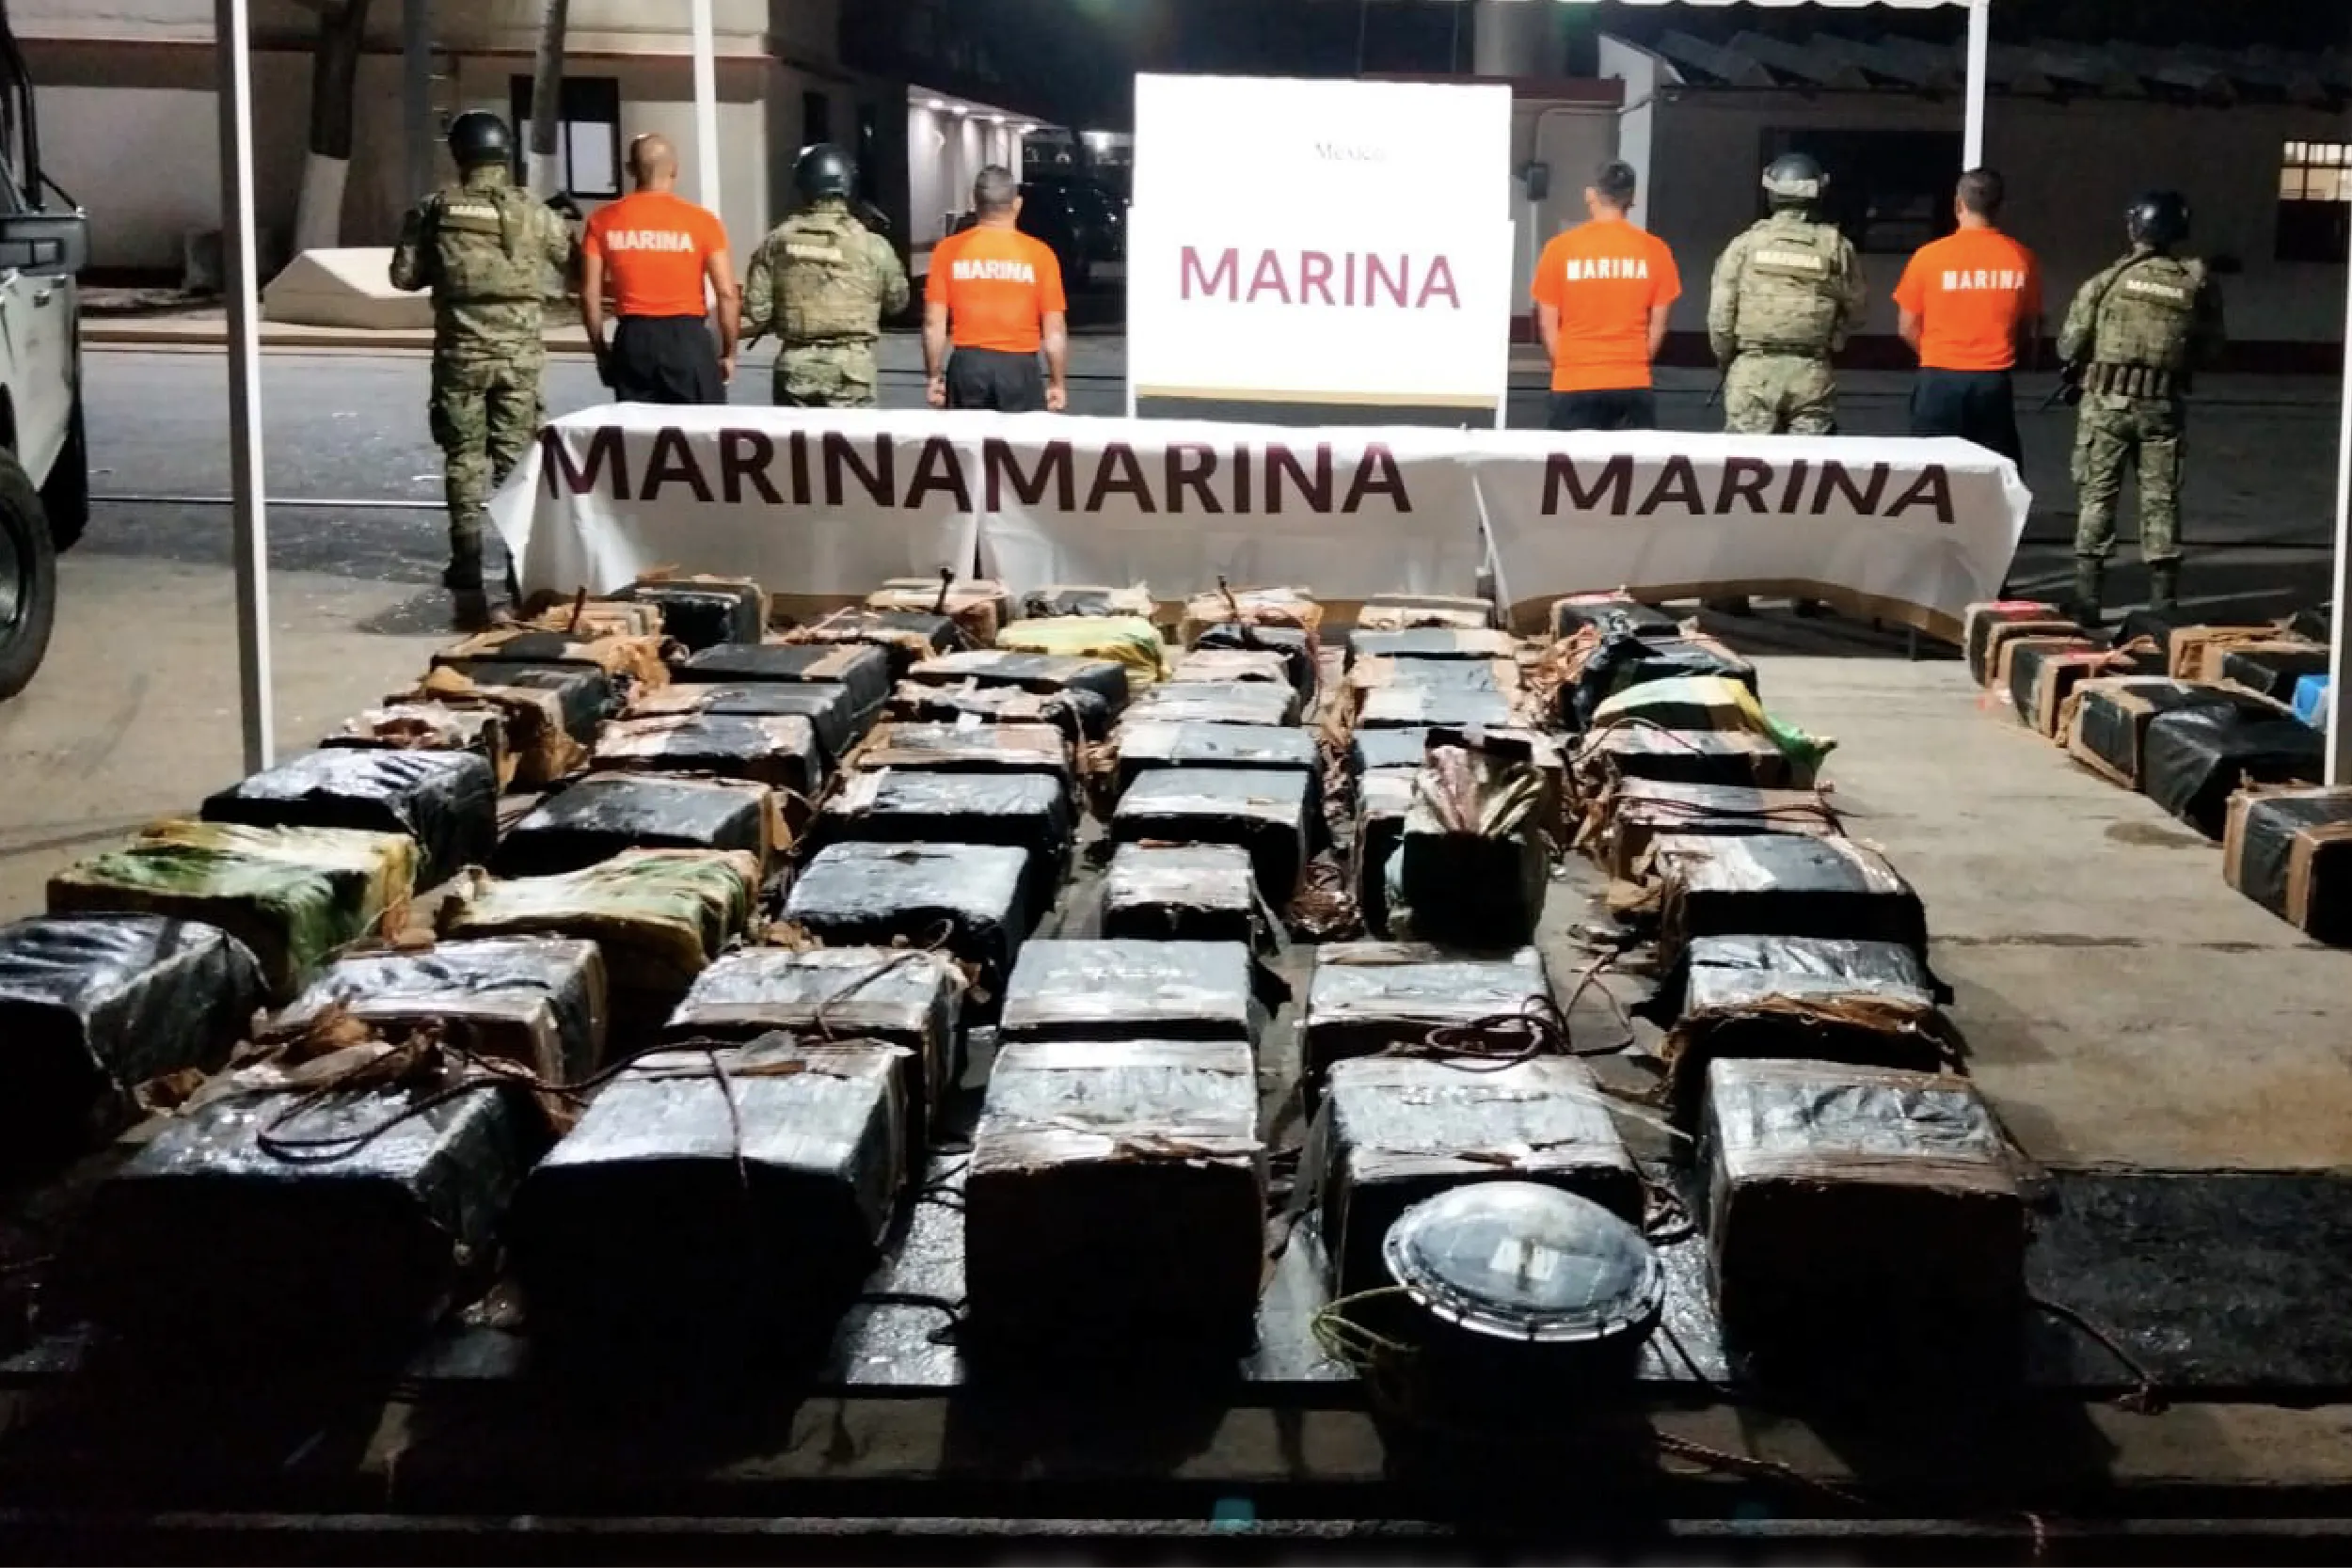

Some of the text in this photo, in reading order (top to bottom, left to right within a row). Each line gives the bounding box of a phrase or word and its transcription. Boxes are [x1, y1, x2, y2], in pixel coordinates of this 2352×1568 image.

[606, 230, 695, 252] MARINA
[952, 259, 1036, 284] MARINA
[1565, 258, 1648, 280] MARINA
[1181, 245, 1460, 309] MARINA
[540, 424, 973, 514] MARINA
[982, 436, 1413, 515] MARINA
[1541, 451, 1955, 525] MARINA
